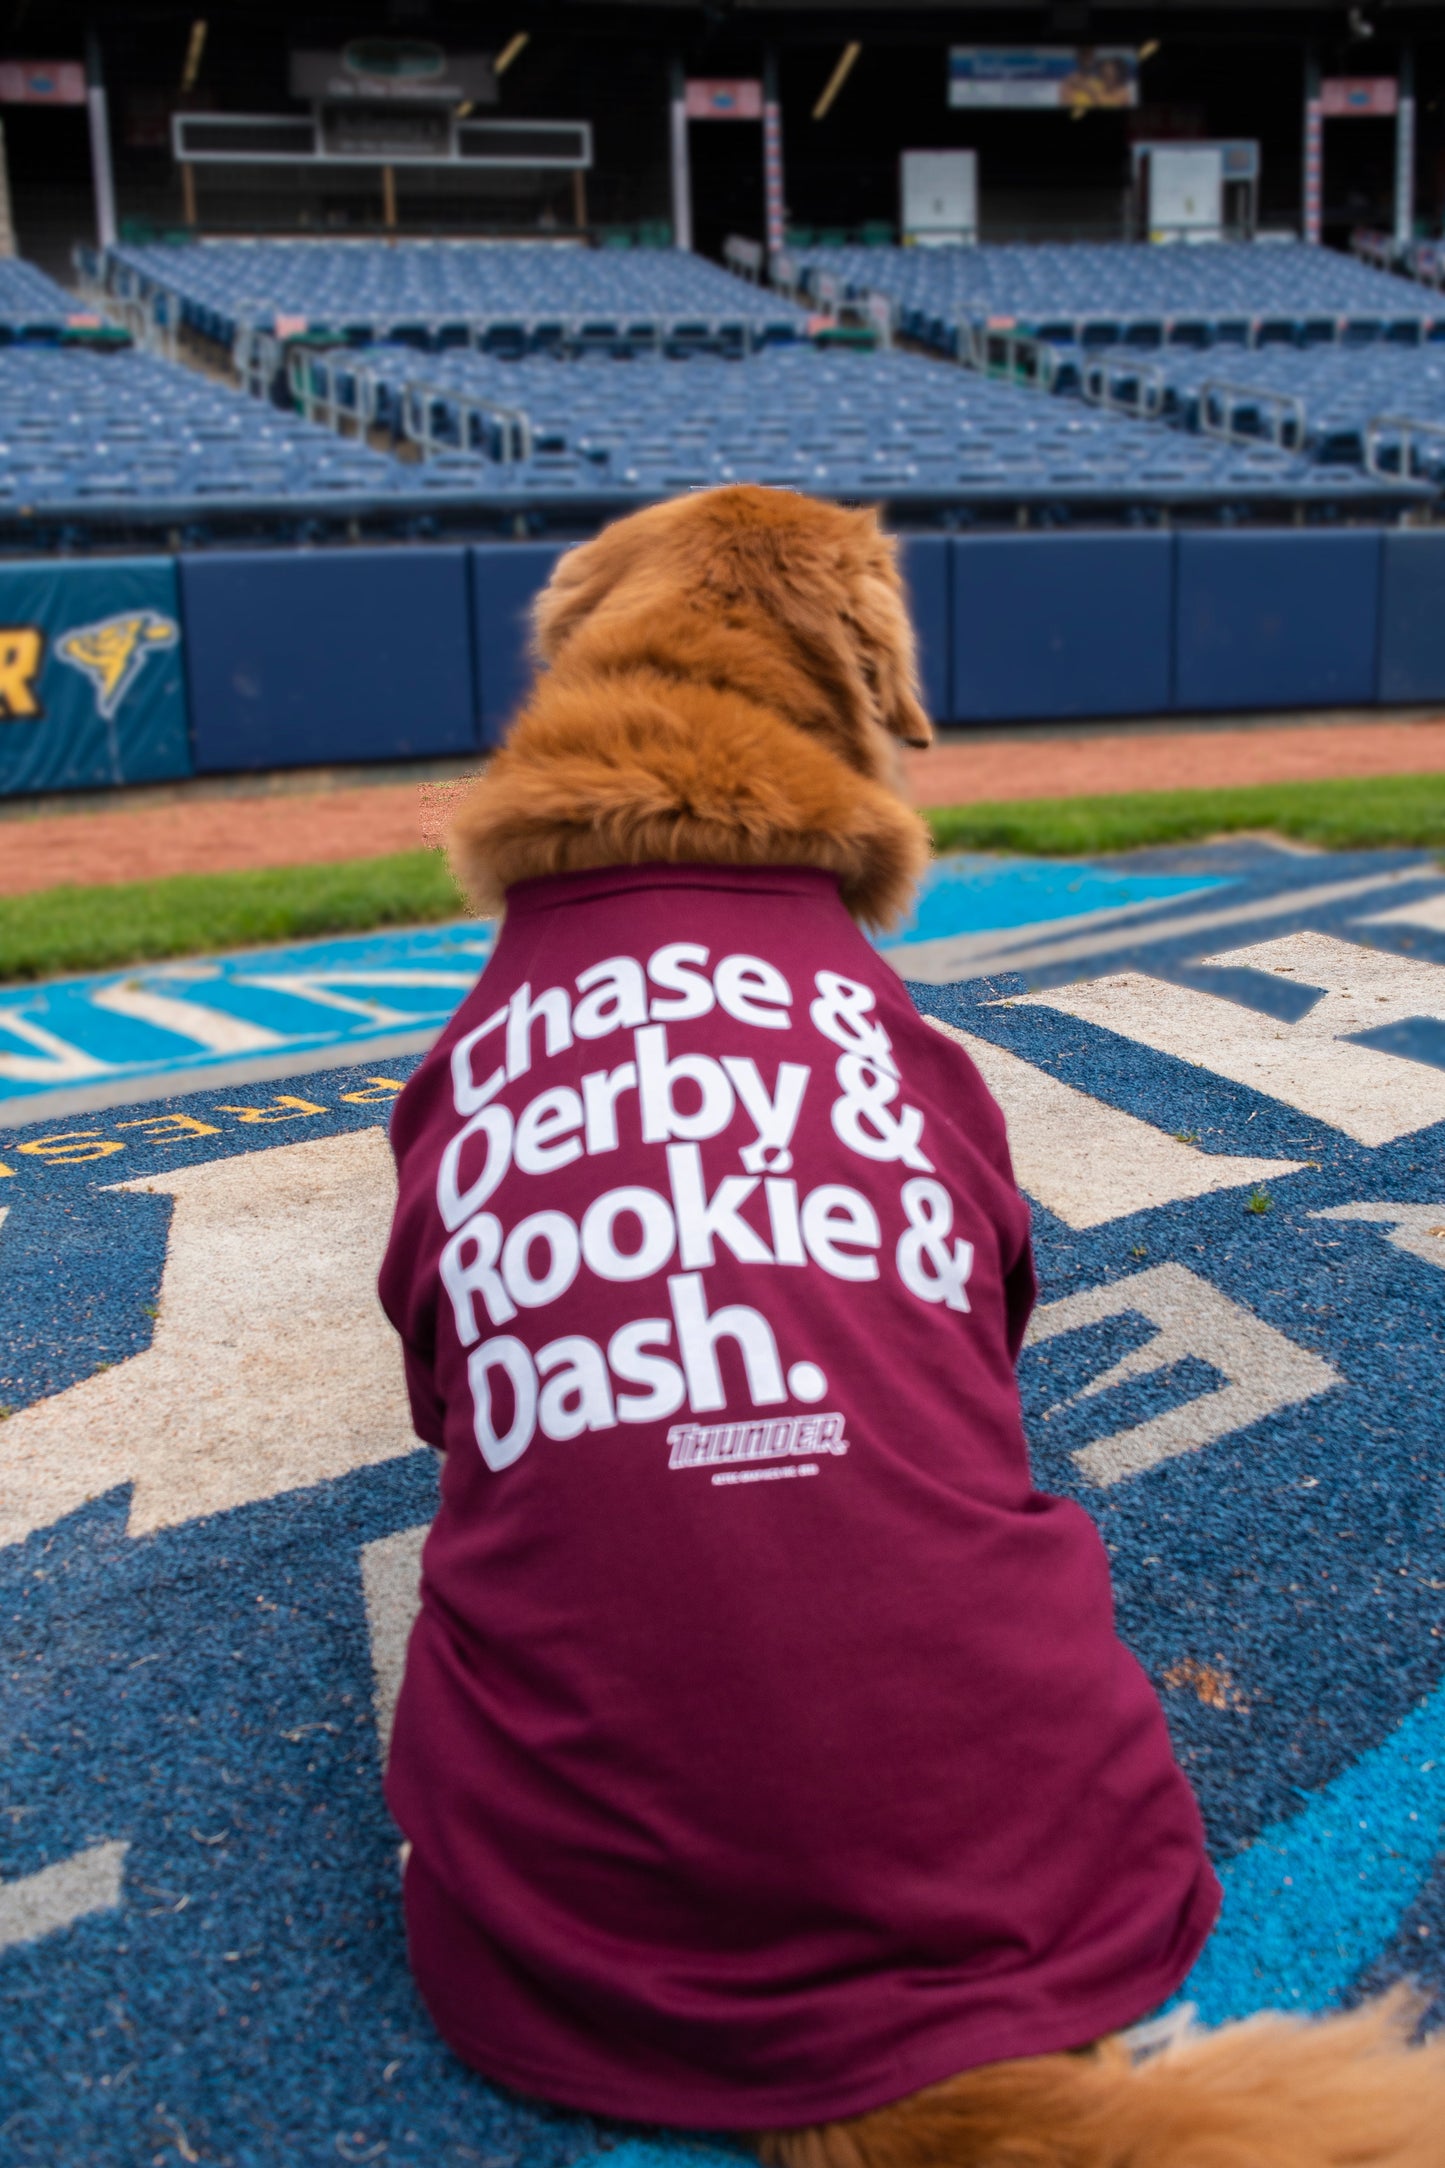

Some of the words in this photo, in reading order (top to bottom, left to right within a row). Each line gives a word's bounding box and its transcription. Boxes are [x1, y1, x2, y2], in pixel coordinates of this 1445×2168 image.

[436, 1023, 811, 1233] Derby
[831, 1052, 936, 1174] &
[451, 942, 793, 1117] Chase
[810, 970, 900, 1077] &
[439, 1141, 882, 1347] Rookie
[896, 1177, 974, 1313] &
[467, 1270, 828, 1473] Dash.
[667, 1412, 849, 1470] THUNDER
